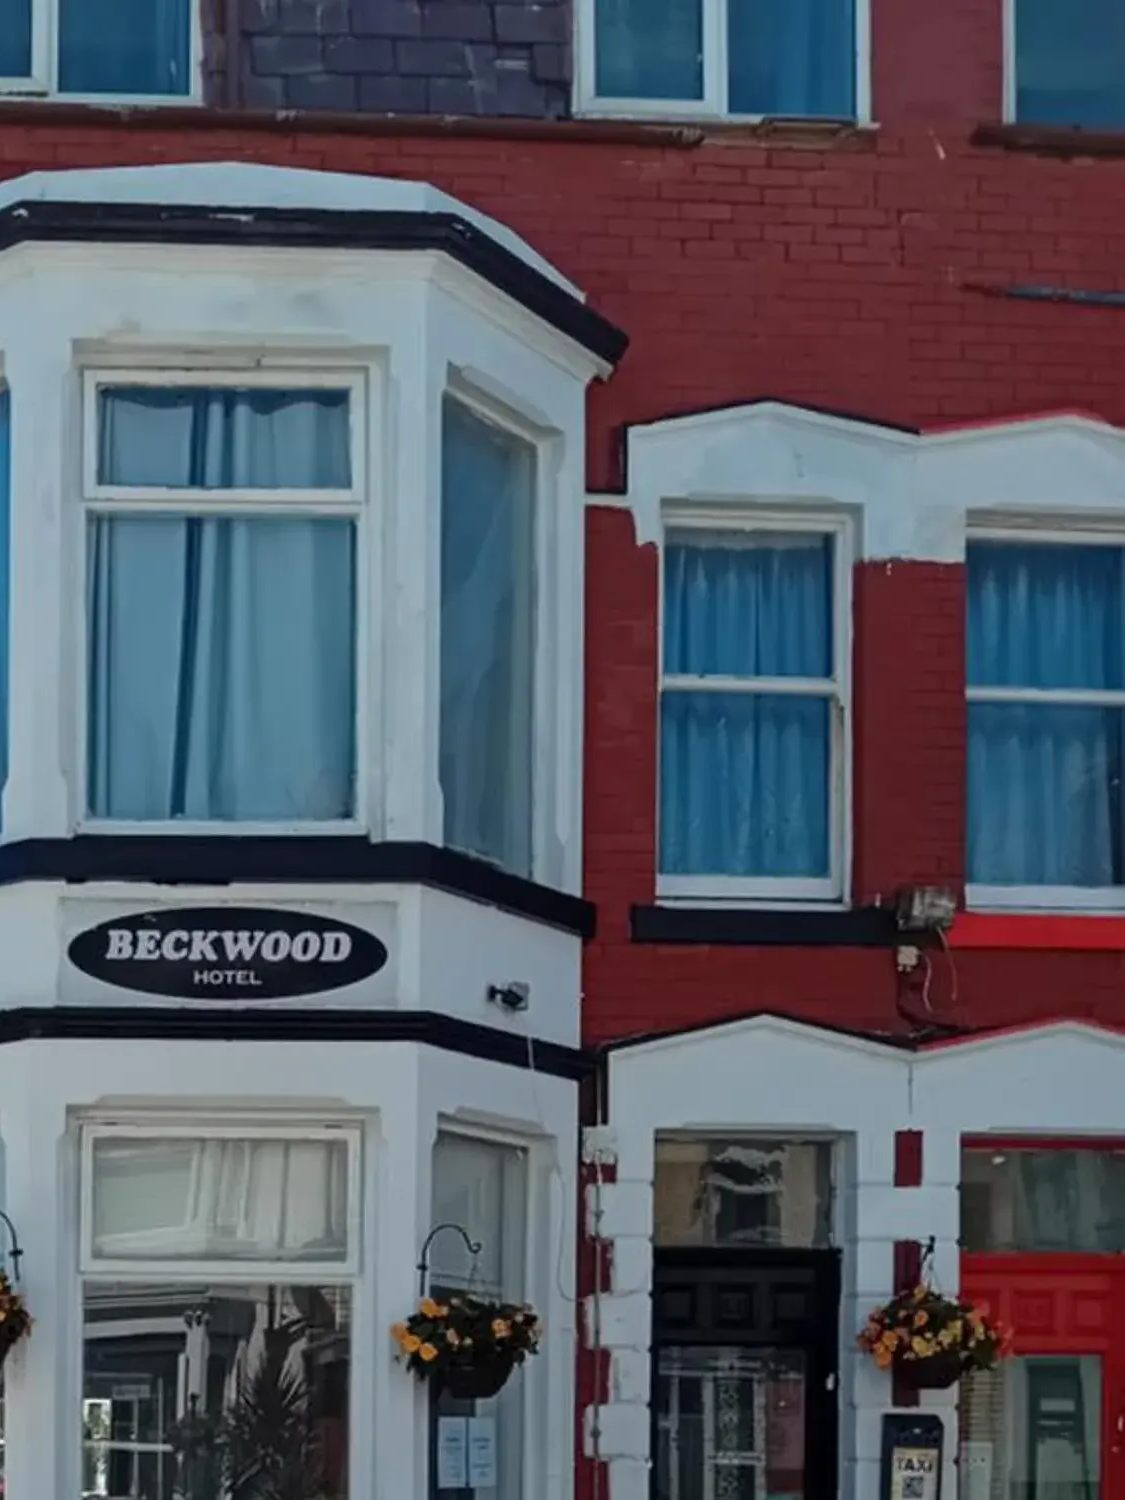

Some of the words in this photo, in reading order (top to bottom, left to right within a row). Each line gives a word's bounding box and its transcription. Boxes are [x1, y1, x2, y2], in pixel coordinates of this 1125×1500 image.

[105, 929, 352, 961] BECKWOOD
[193, 969, 262, 985] HOTEL
[896, 1457, 933, 1473] TAXI
